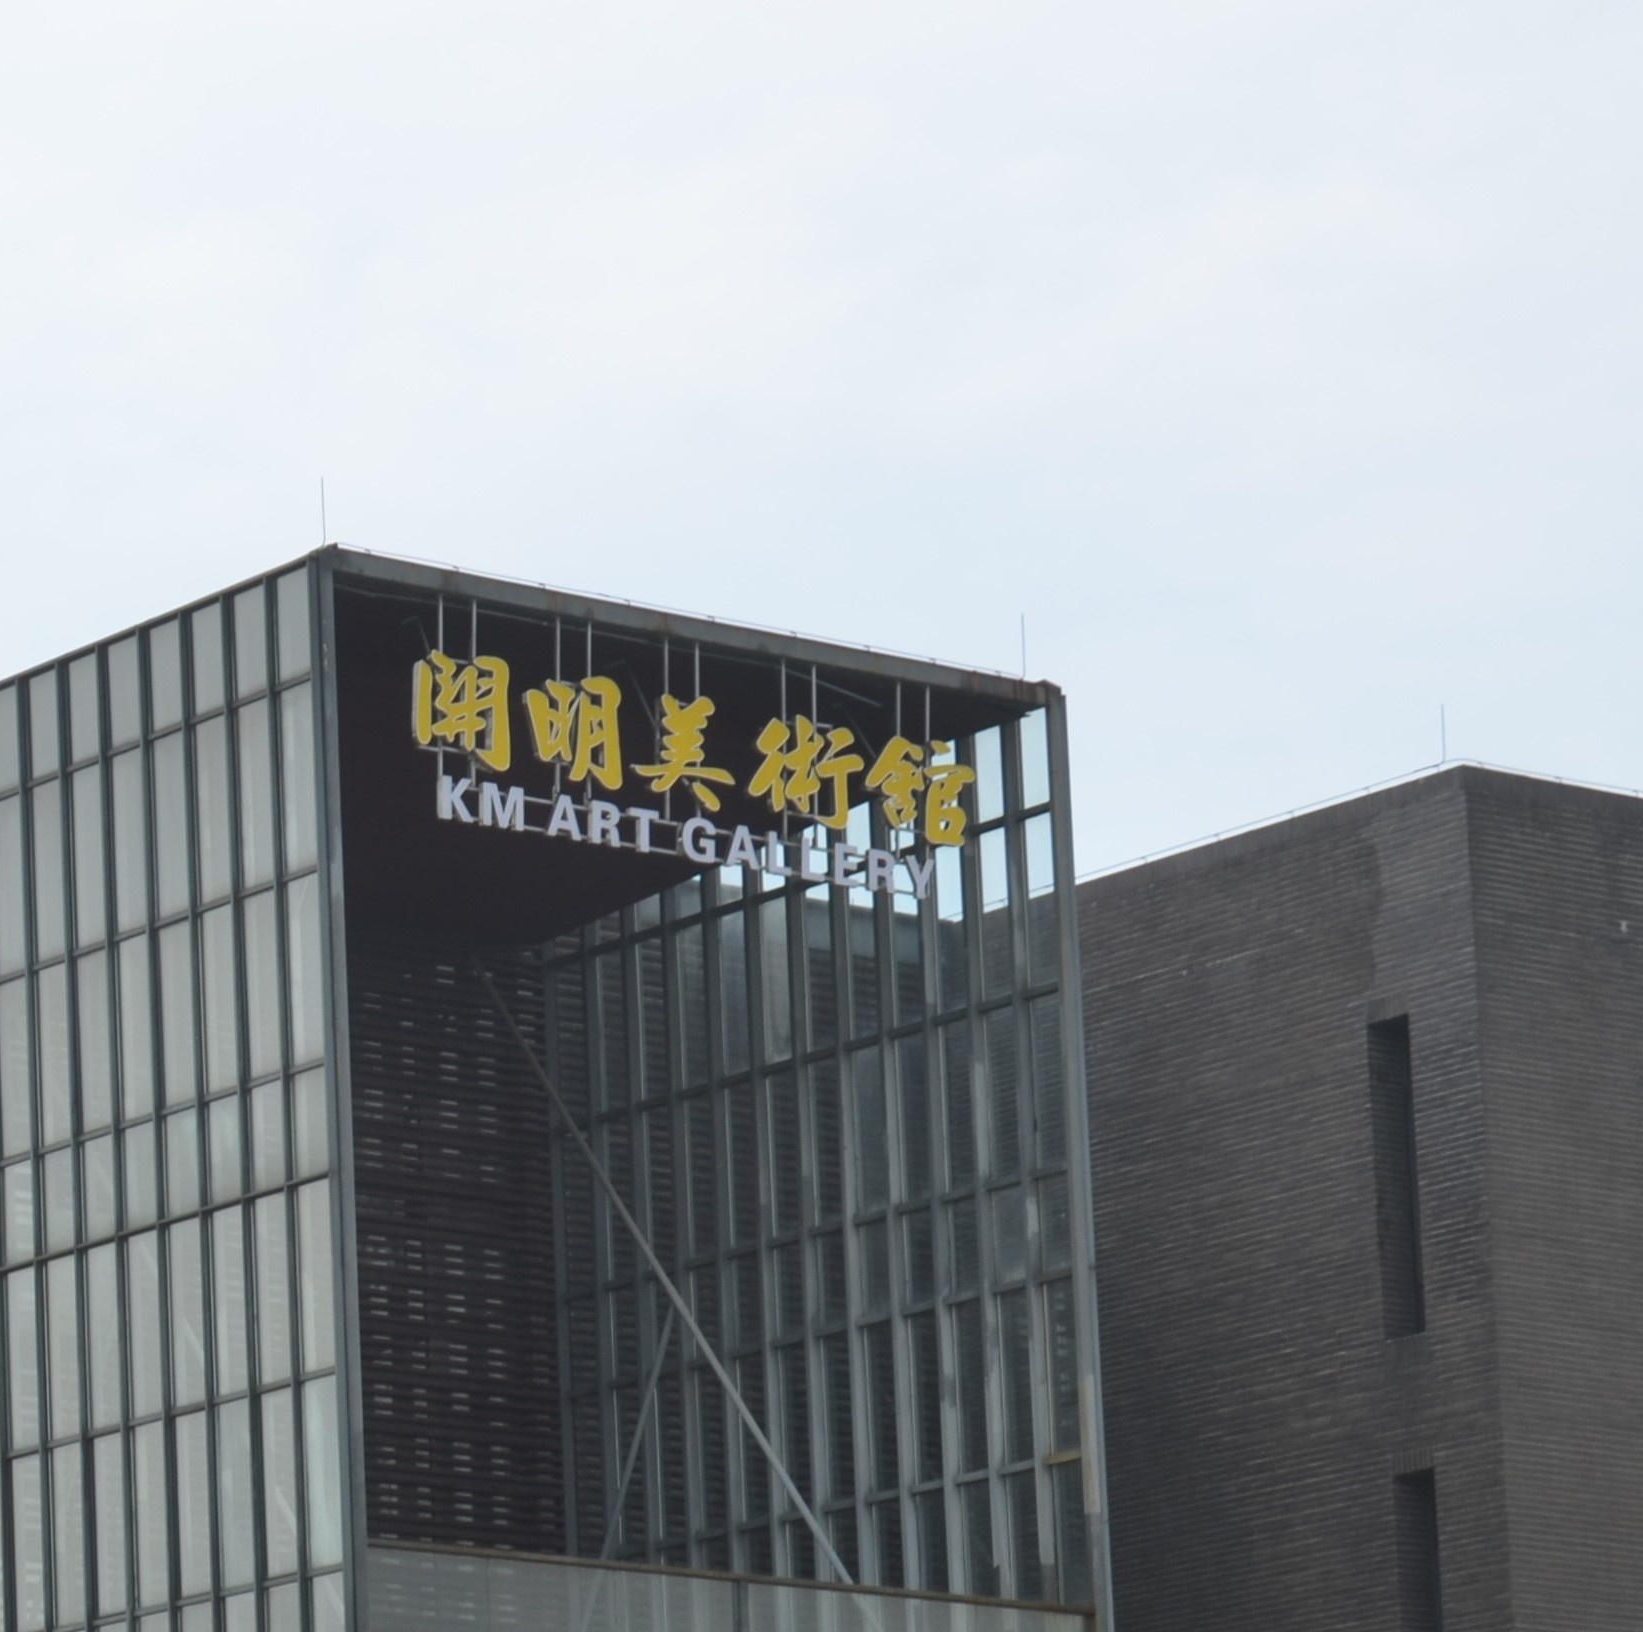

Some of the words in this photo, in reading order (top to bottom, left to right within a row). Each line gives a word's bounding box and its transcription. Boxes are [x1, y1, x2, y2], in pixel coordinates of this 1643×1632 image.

[413, 648, 976, 847] 開明美術館
[437, 774, 525, 832] KM
[546, 794, 660, 854] ART
[681, 816, 935, 900] GALLERY
